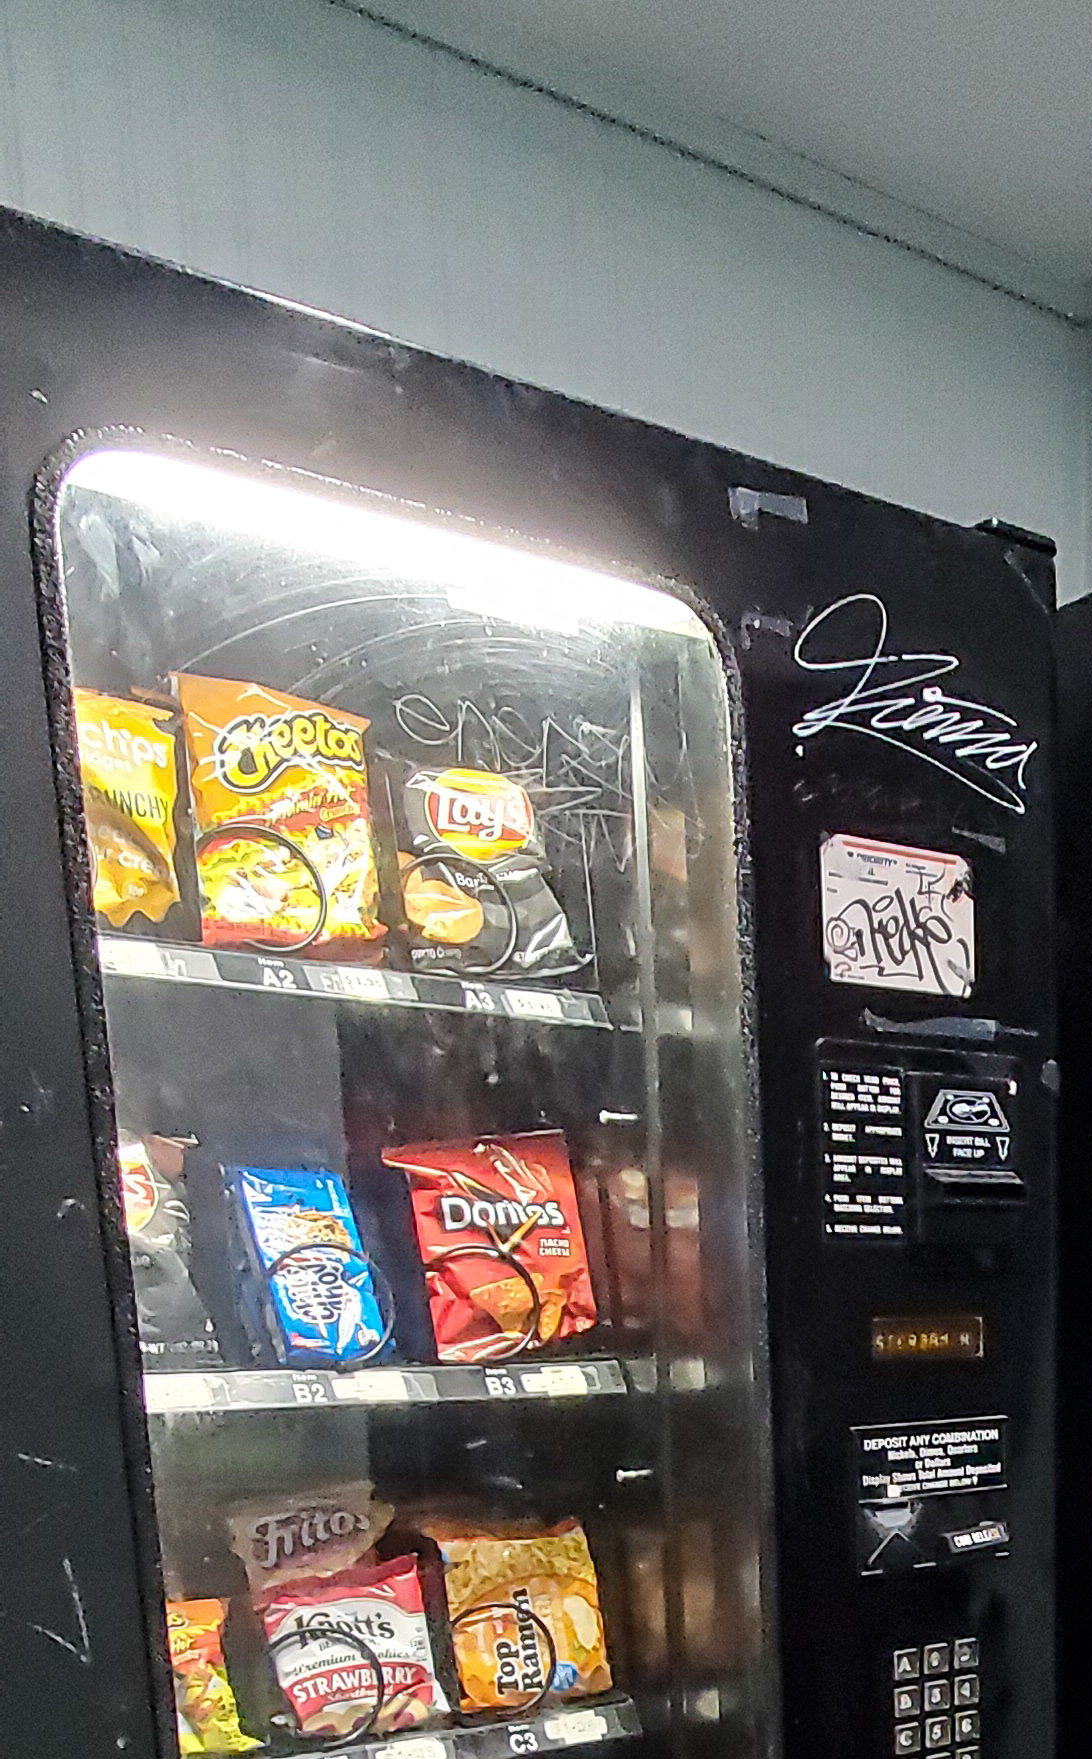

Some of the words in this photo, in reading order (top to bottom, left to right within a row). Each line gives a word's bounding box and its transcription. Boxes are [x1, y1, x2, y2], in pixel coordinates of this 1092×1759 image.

[217, 711, 365, 790] Cheetos
[262, 966, 297, 990] A2
[464, 990, 496, 1011] A3
[440, 1196, 565, 1231] Doritos
[292, 1383, 329, 1404] B2
[485, 1377, 517, 1396] B3
[863, 1436, 908, 1451] DEPOSIT
[909, 1434, 931, 1447] ANY
[932, 1428, 999, 1445] COMBINATION
[252, 1509, 370, 1569] Fritos
[294, 1611, 395, 1650] Knott's
[496, 1641, 520, 1696] Top
[510, 1731, 539, 1755] C3
